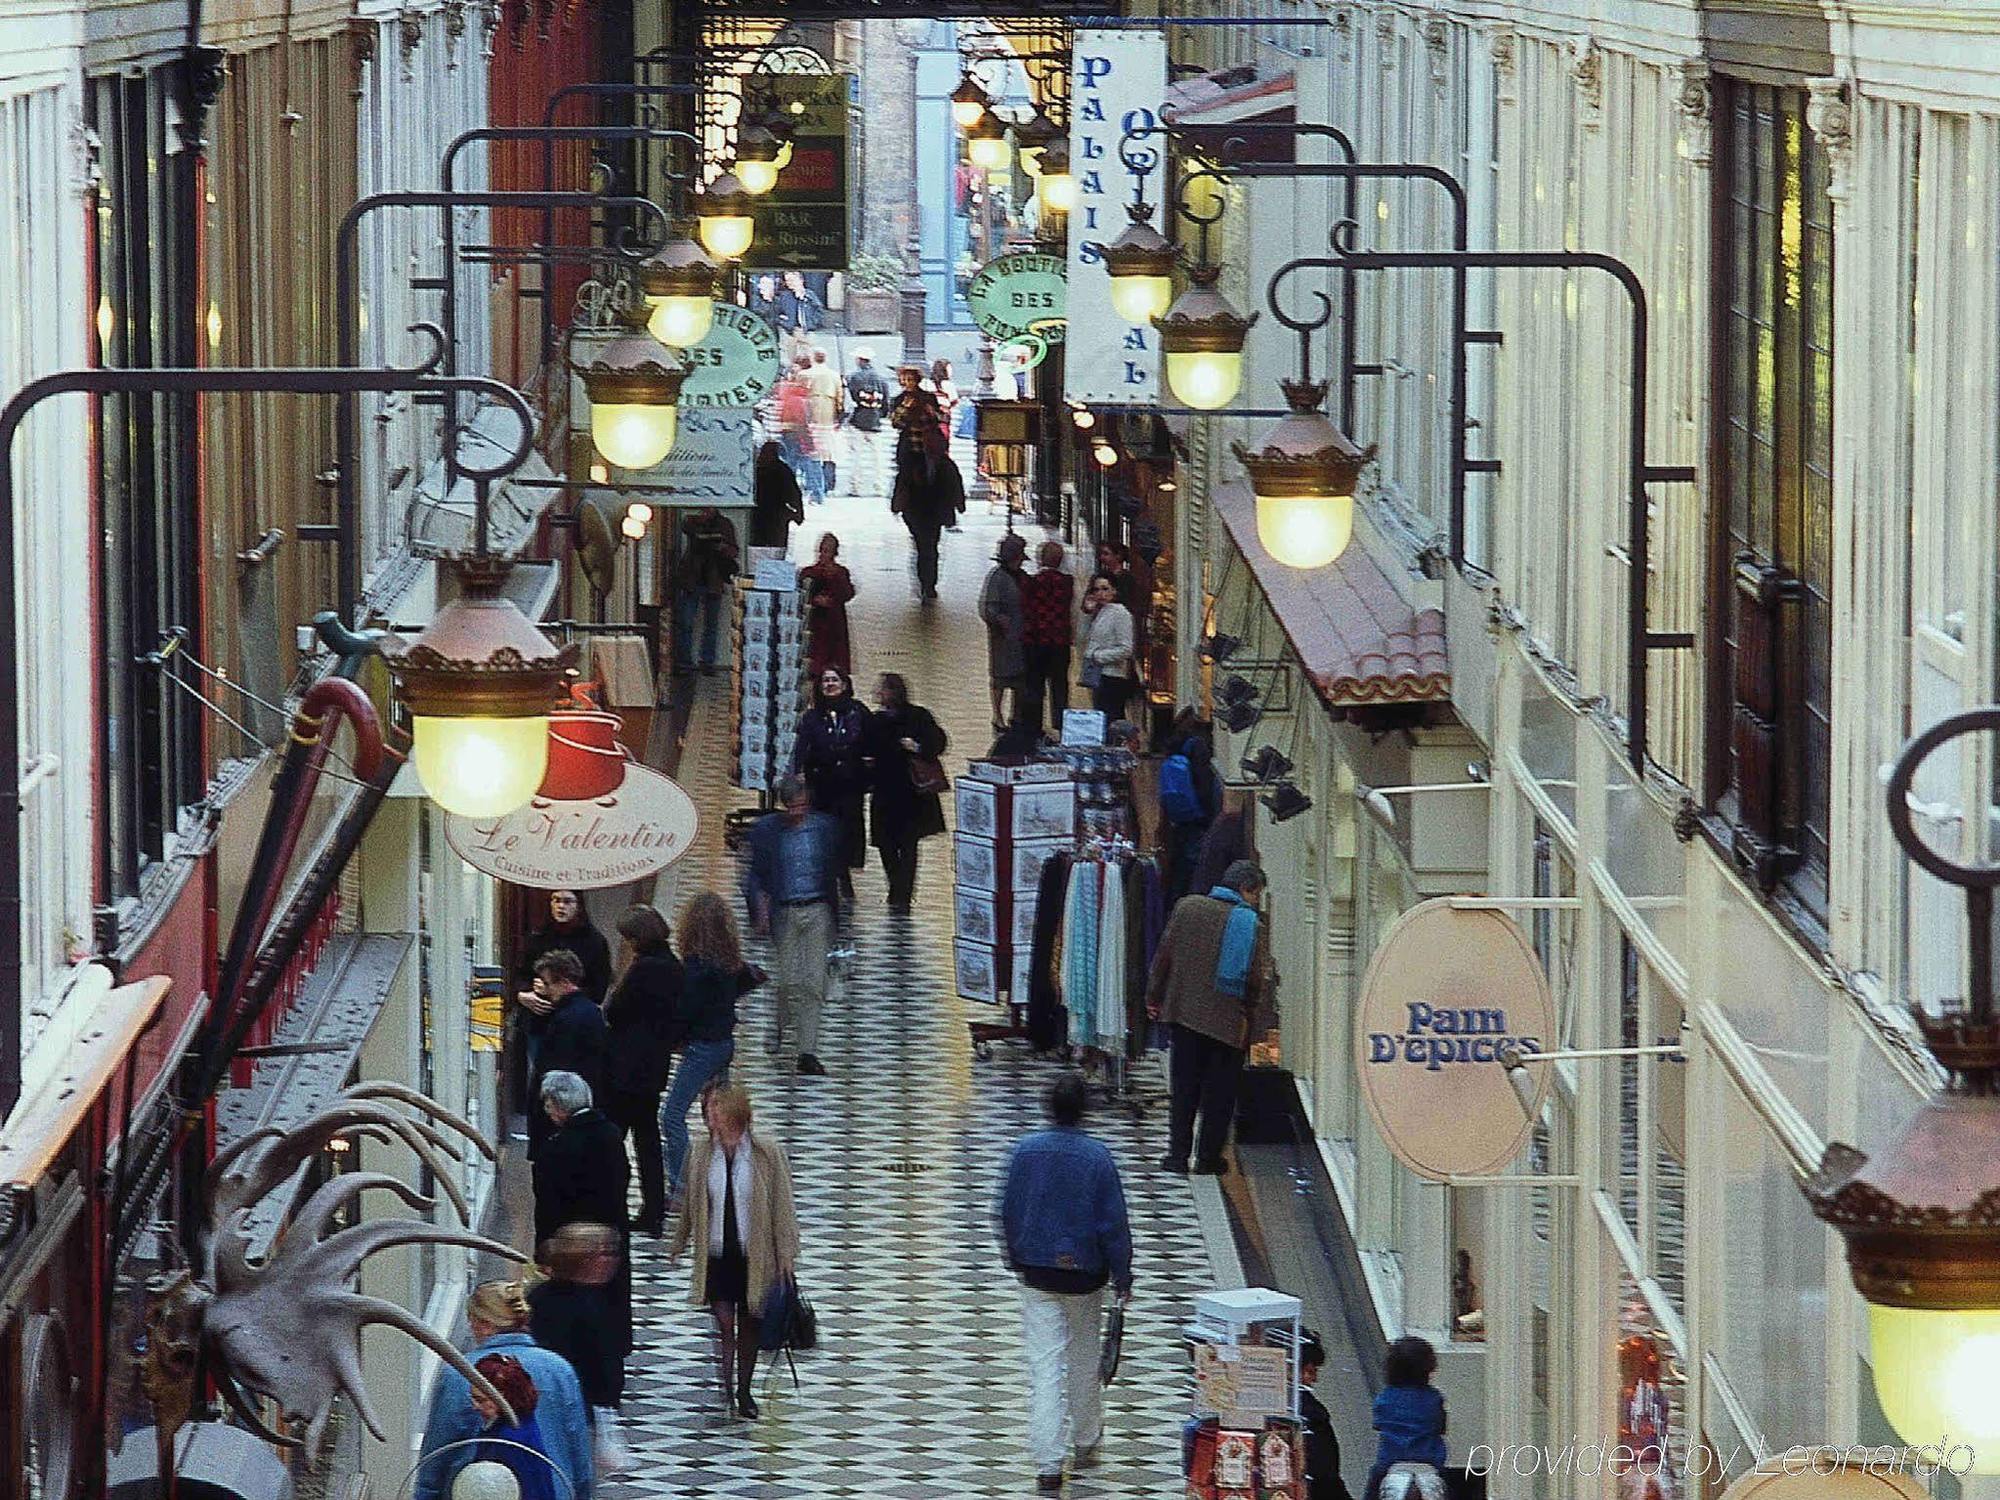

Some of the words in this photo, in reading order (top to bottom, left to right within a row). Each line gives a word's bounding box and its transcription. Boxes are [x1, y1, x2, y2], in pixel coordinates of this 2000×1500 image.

[1077, 56, 1112, 265] PALAIS
[471, 814, 520, 852] Le
[527, 813, 676, 851] Valentin
[493, 855, 551, 880] Cuisine
[556, 871, 573, 881] et
[1407, 1001, 1506, 1035] Pain
